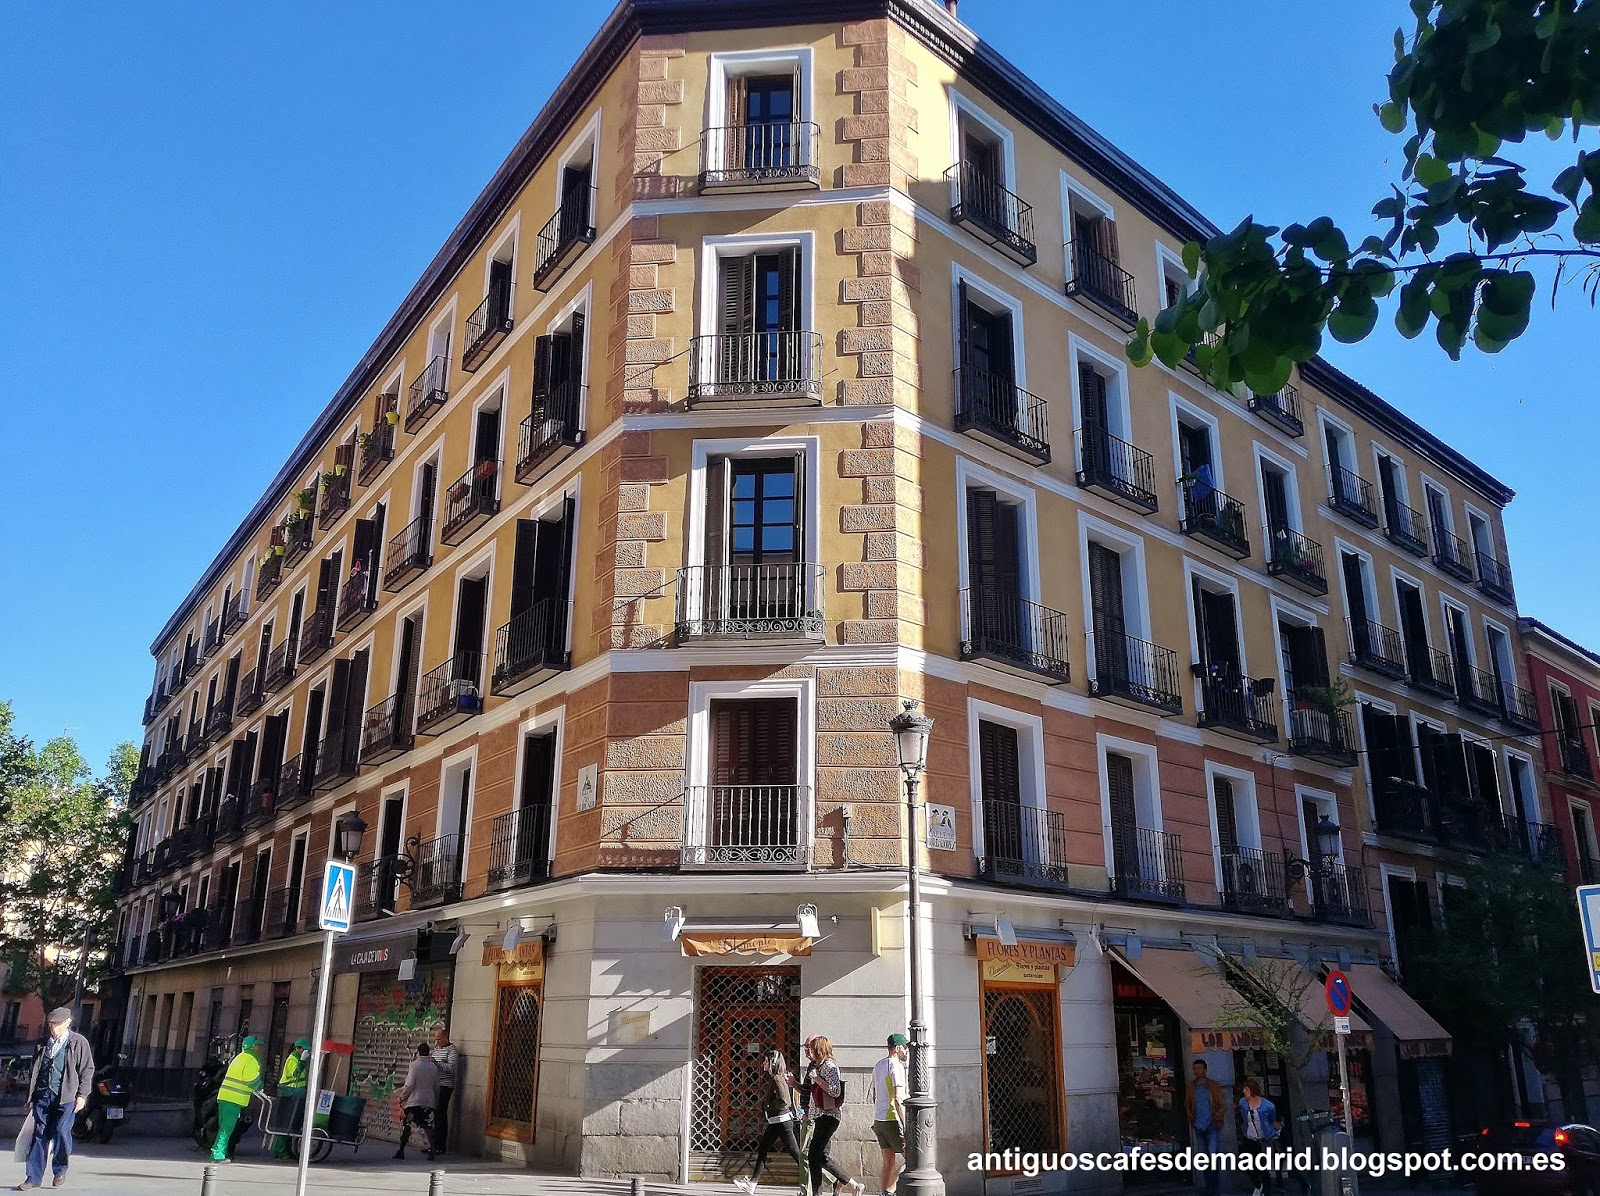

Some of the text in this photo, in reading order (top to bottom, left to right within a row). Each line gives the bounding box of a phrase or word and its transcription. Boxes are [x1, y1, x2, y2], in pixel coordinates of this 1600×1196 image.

[987, 942, 1067, 961] FLORES Y PLANTAS
